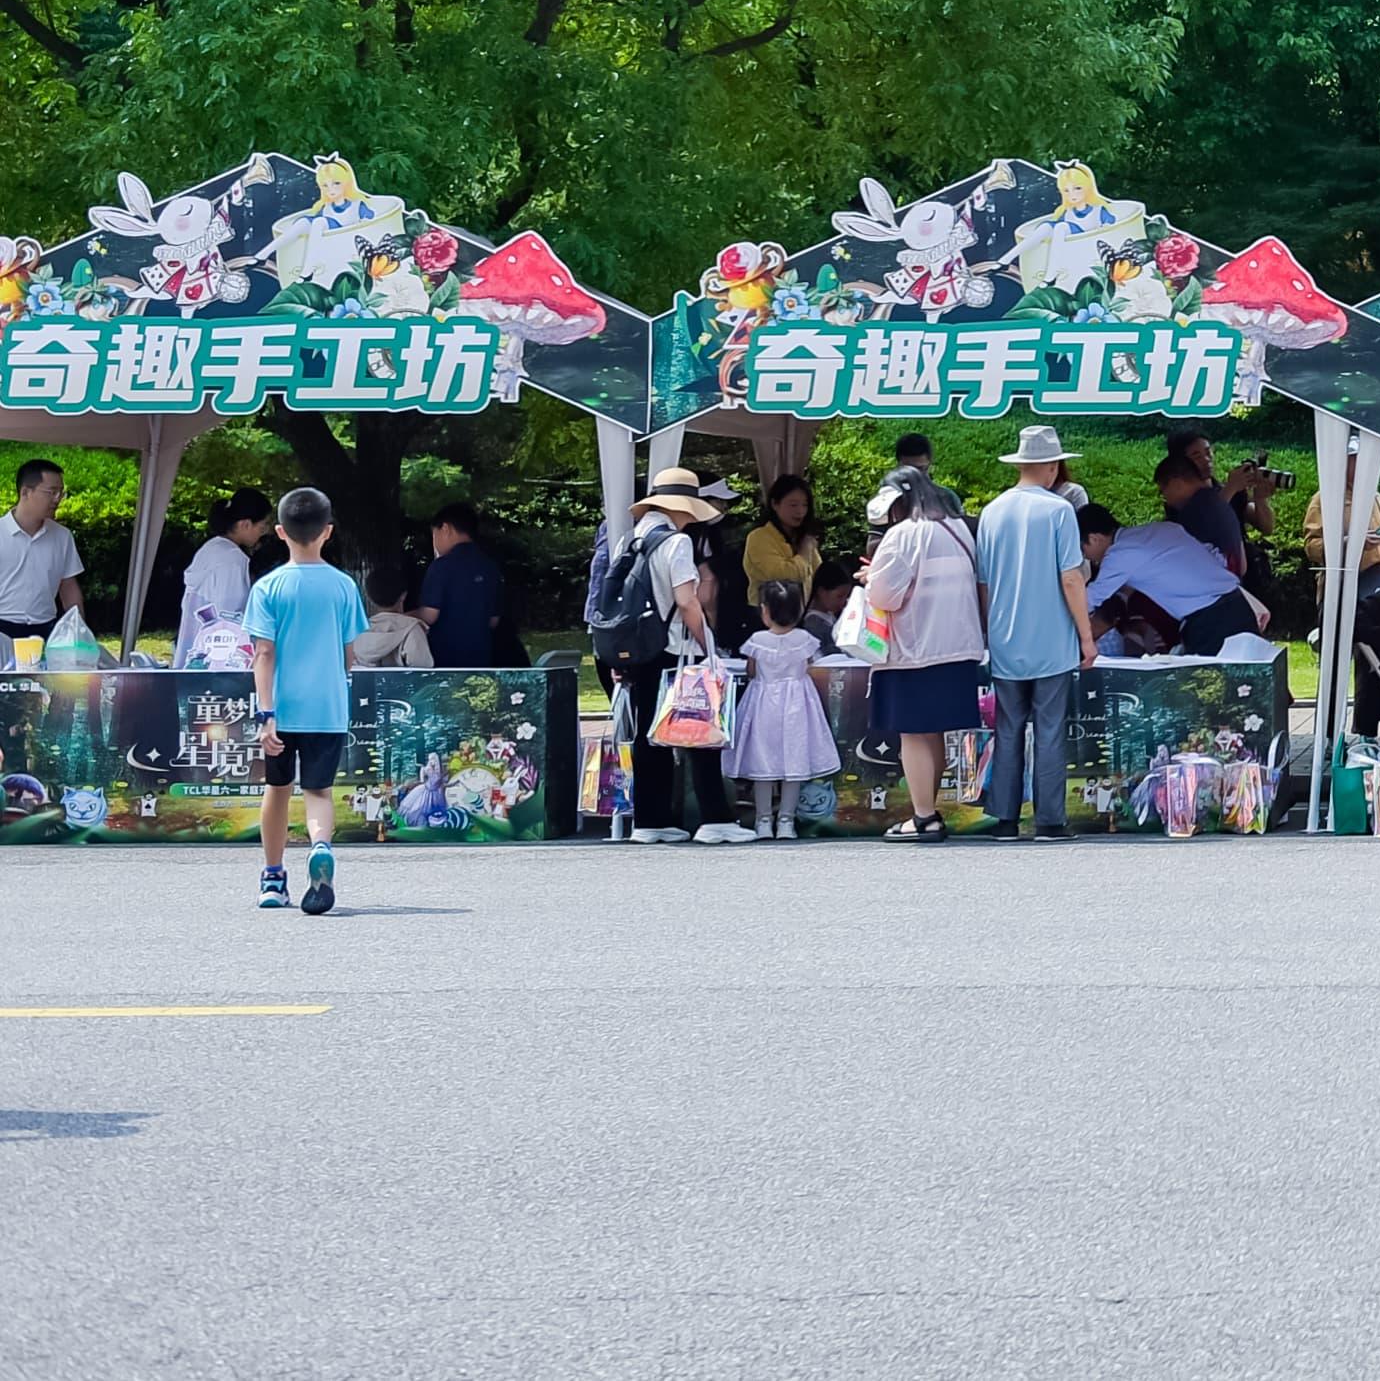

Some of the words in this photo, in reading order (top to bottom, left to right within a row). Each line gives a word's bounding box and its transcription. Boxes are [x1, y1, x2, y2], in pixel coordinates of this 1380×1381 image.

[7, 324, 492, 404] 奇趣手工坊
[754, 328, 1234, 408] 奇趣手工坊
[188, 690, 257, 726] 童梦
